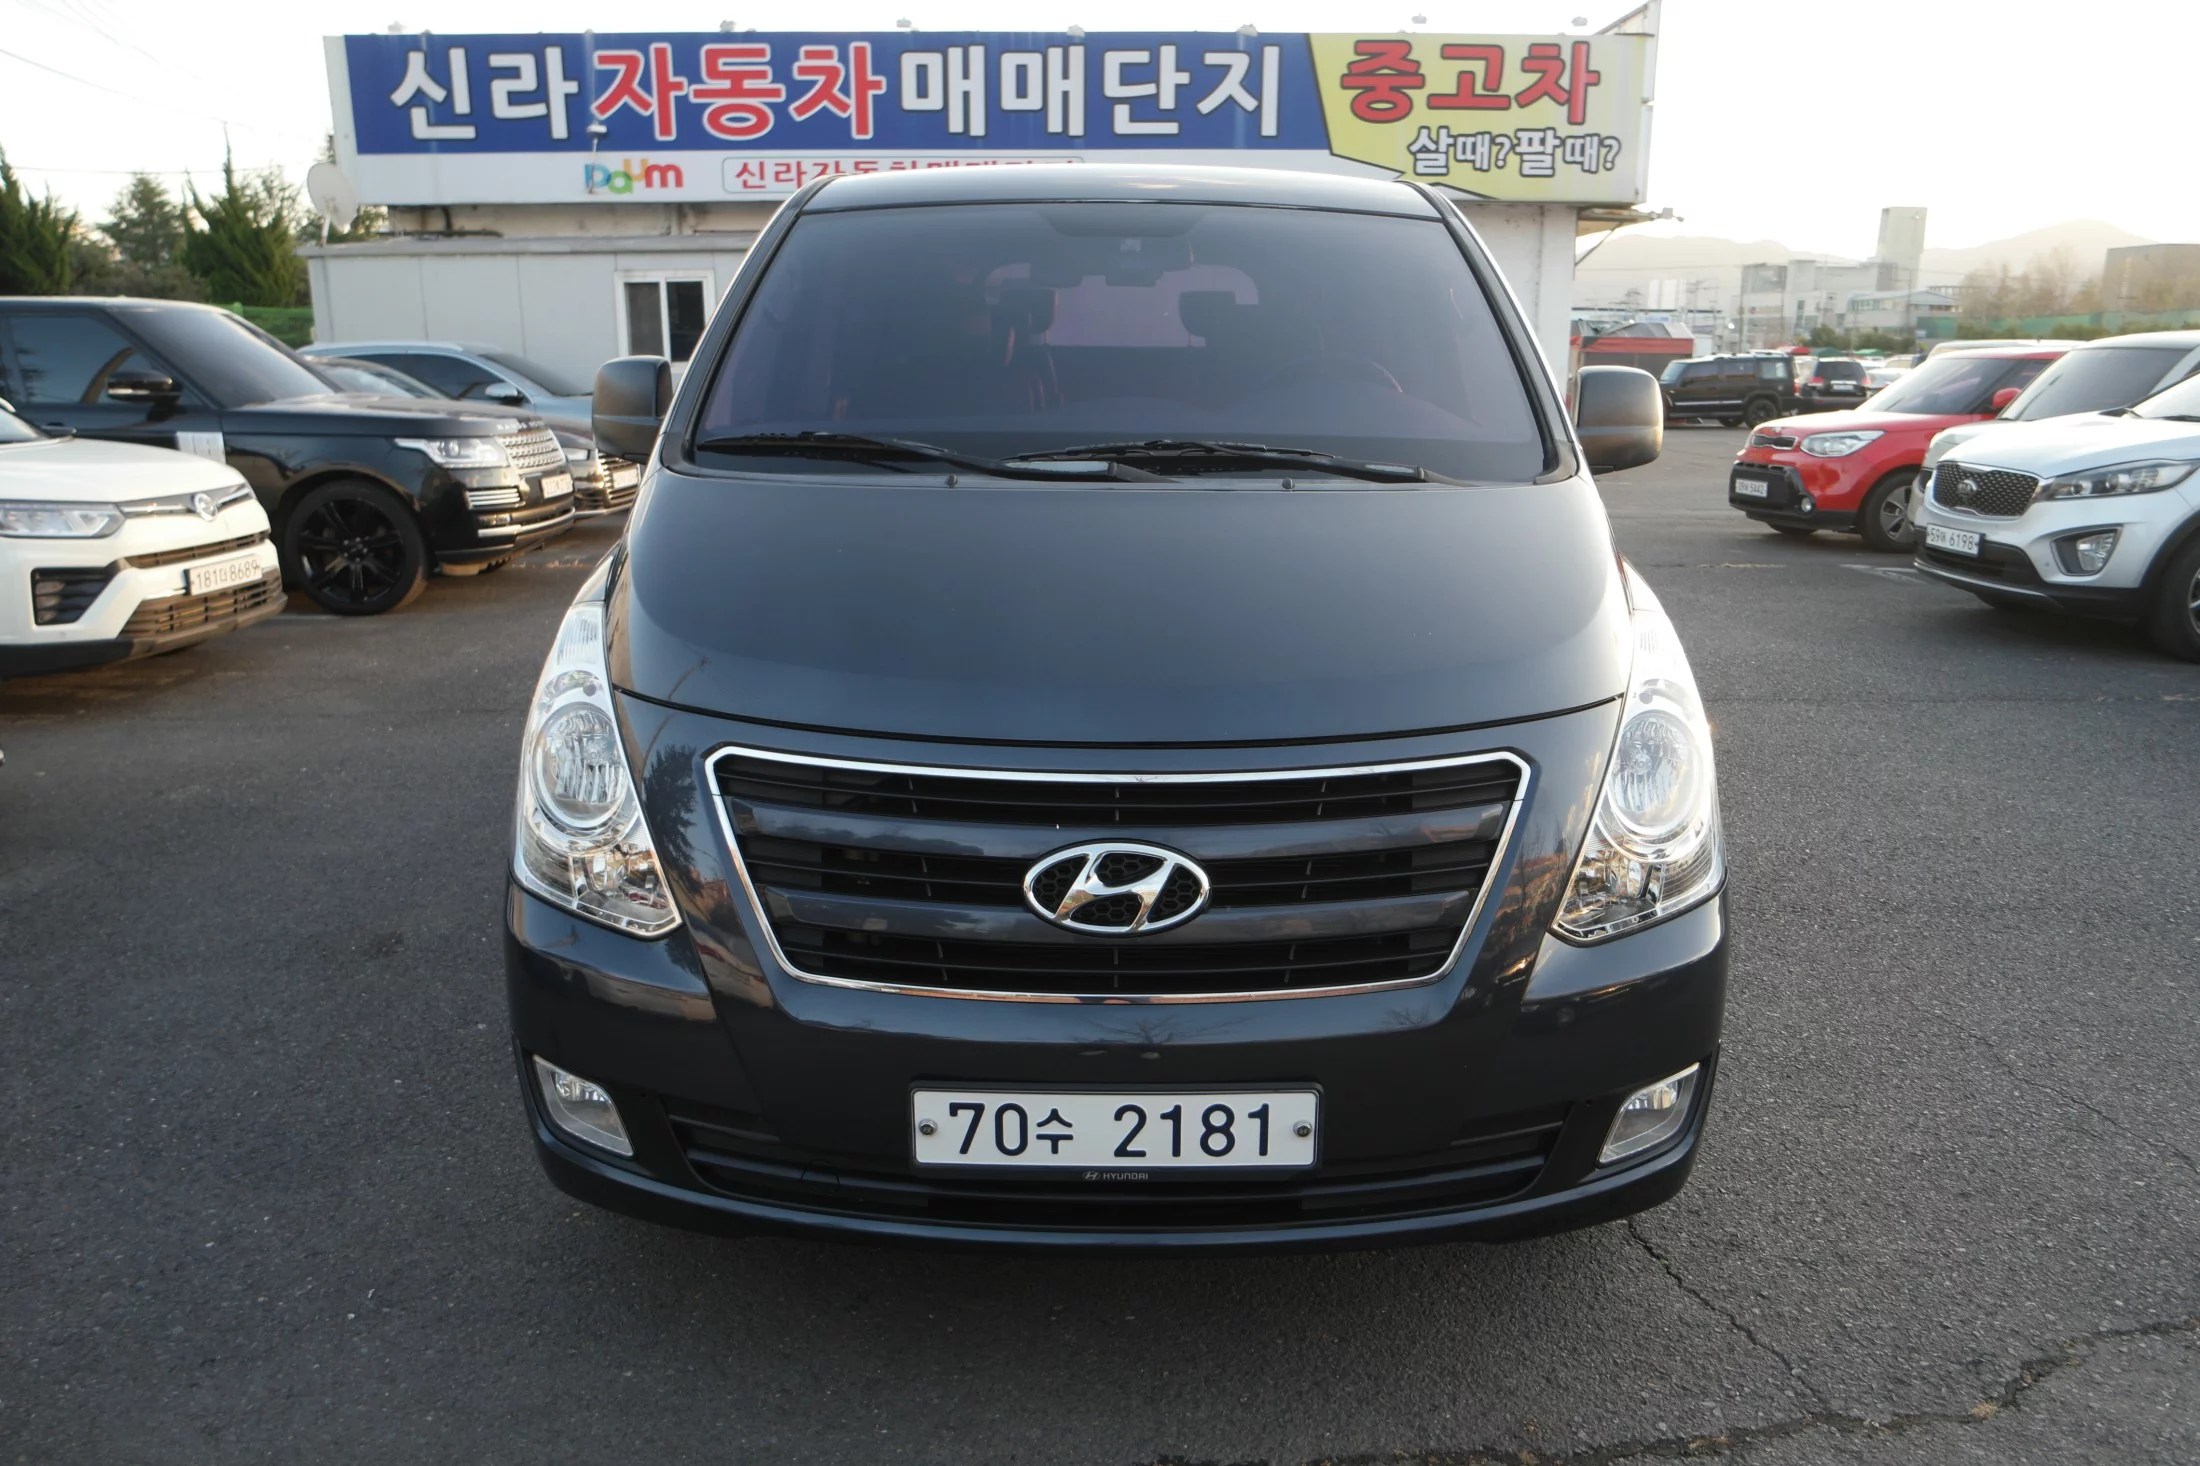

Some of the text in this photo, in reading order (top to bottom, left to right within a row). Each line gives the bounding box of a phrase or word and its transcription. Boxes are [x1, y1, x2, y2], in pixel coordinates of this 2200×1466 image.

[1340, 40, 1600, 125] 중고차
[949, 1102, 1270, 1158] 70수 2181
[1102, 1172, 1148, 1180] HYUNDAI
